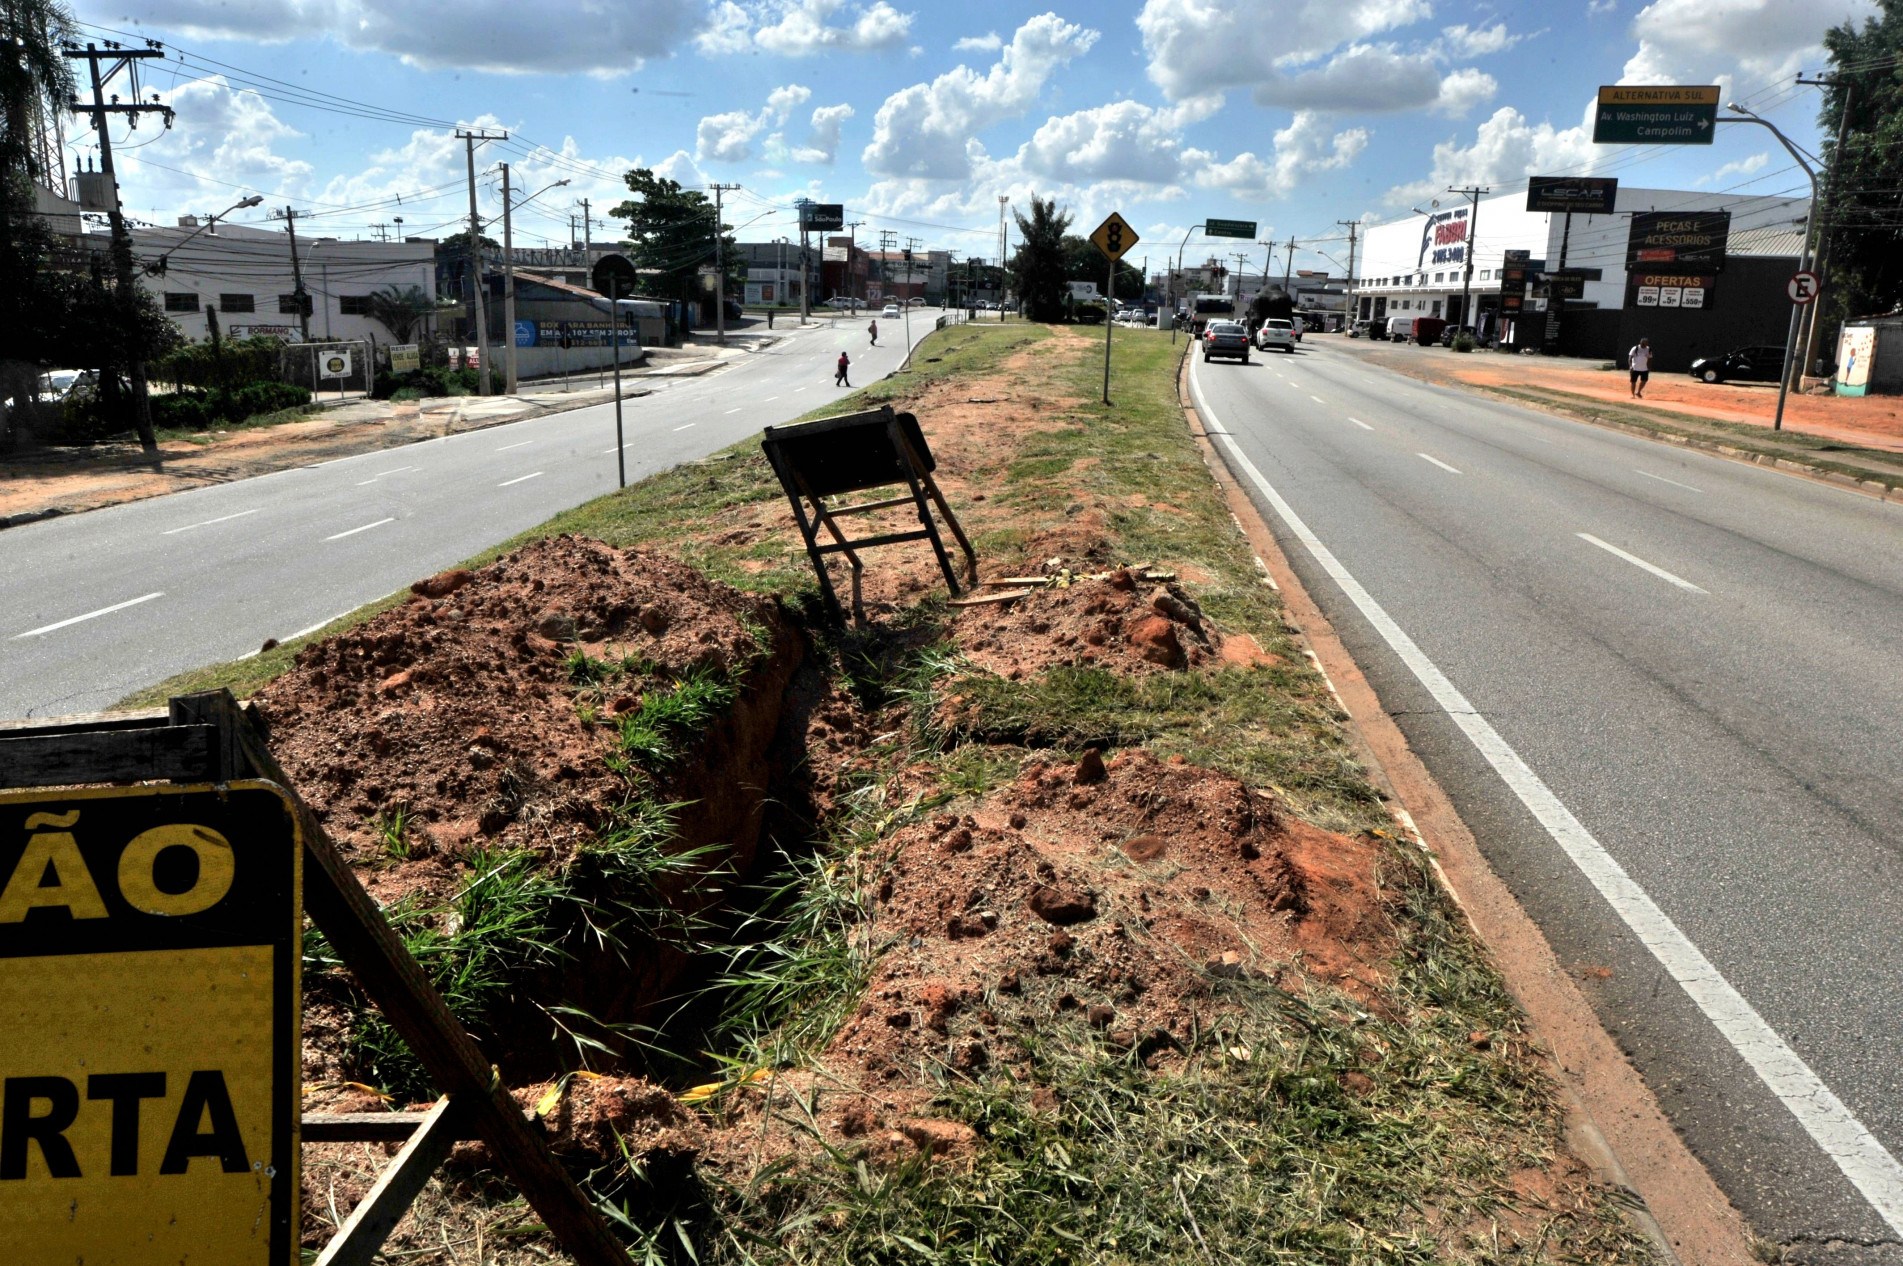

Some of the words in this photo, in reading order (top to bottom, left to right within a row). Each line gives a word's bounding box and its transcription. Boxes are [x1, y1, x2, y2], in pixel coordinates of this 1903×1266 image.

[1613, 90, 1681, 100] ALTERNATIVA
[1685, 90, 1704, 100] SUL
[1601, 112, 1613, 121] Av.
[1617, 111, 1671, 123] Washington
[1674, 111, 1694, 121] Luiz
[1636, 126, 1692, 138] Campolim
[1541, 188, 1604, 199] LSCAR
[1693, 221, 1701, 232] E
[1435, 220, 1467, 246] FABBRI
[1645, 275, 1701, 287] OFERTAS
[540, 321, 560, 329] BOX
[0, 809, 235, 924] ÃO
[0, 1070, 252, 1181] RTA
